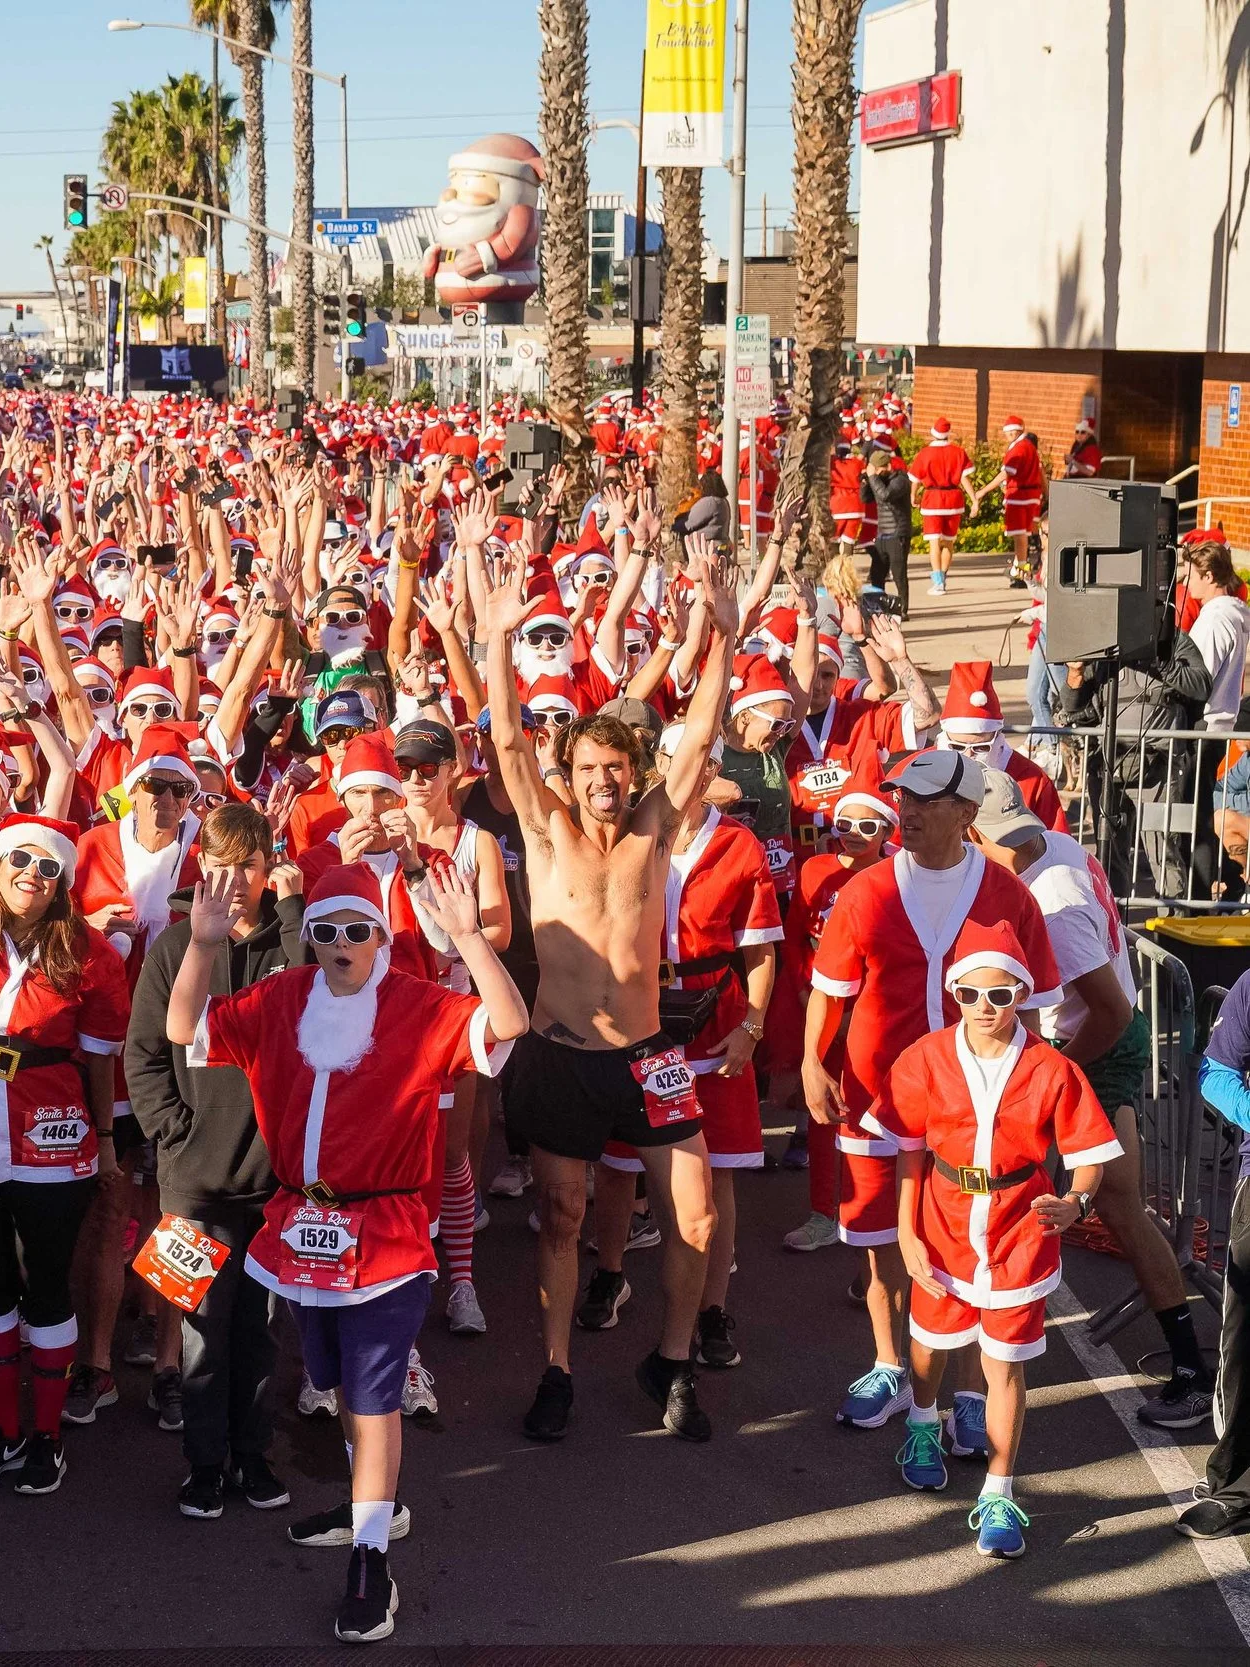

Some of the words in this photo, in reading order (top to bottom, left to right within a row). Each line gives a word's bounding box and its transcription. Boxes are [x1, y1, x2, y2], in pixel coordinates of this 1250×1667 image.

[667, 128, 695, 145] local
[327, 223, 359, 234] BAYARD
[737, 316, 748, 330] 2
[749, 321, 767, 330] HOUR
[738, 333, 767, 342] PARKING
[738, 369, 750, 382] NO
[825, 759, 842, 769] Run
[813, 771, 839, 787] 1734
[767, 838, 784, 849] Run
[768, 851, 782, 866] 24
[640, 1058, 667, 1076] Santa
[655, 1067, 690, 1090] 4256
[34, 1106, 63, 1121] Santa
[66, 1106, 84, 1119] Run
[41, 1123, 78, 1140] 1464
[293, 1207, 324, 1222] Santa
[328, 1211, 352, 1225] Run
[171, 1217, 197, 1243] Santa
[196, 1237, 219, 1256] Run
[299, 1228, 339, 1249] 1529
[166, 1238, 204, 1272] 1524
